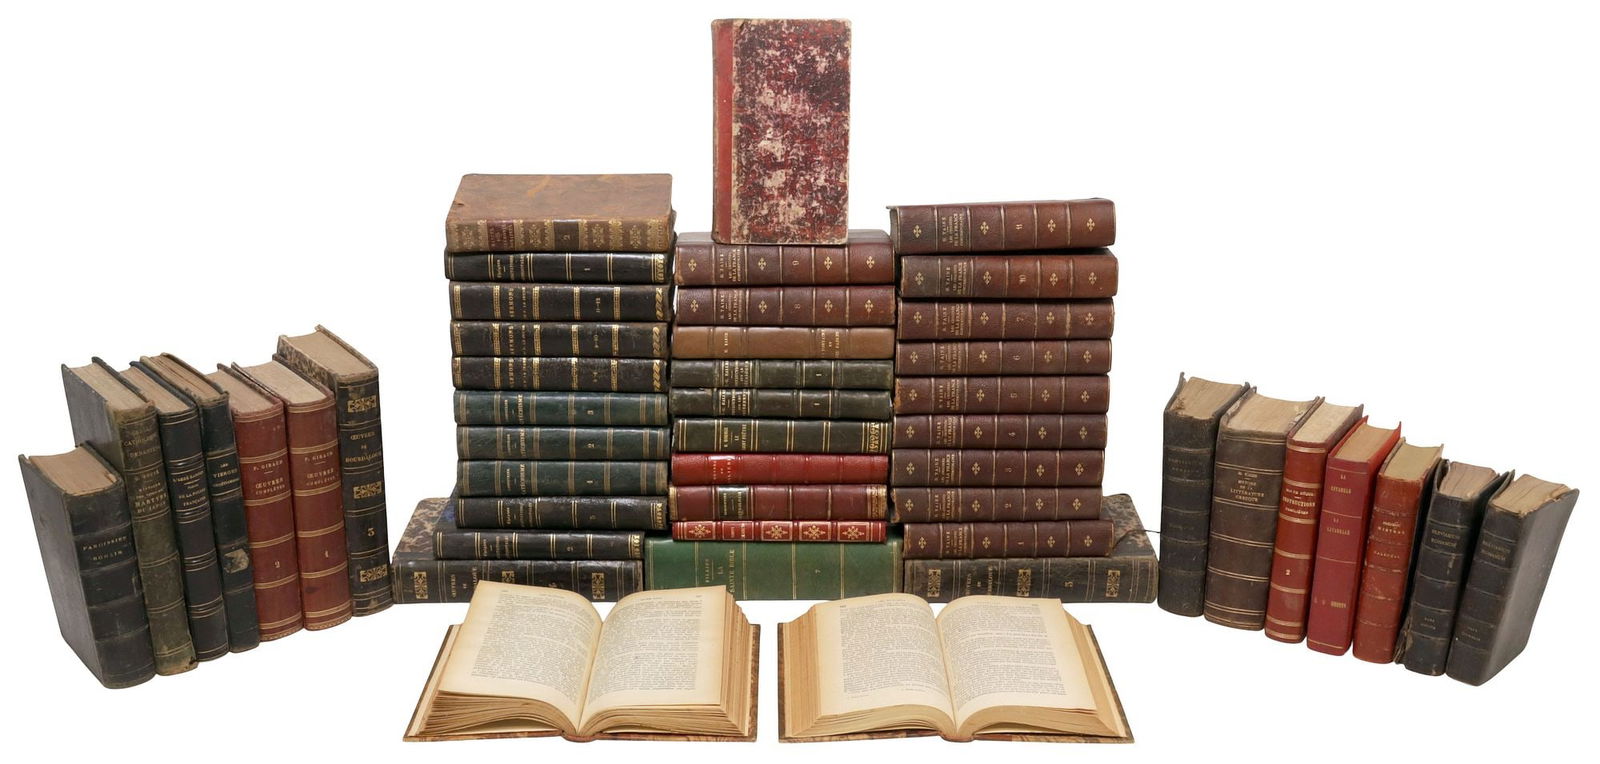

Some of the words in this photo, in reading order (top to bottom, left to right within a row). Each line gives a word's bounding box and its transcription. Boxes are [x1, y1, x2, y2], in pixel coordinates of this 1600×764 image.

[1019, 274, 1026, 284] 10
[312, 451, 333, 460] GIRAUD
[261, 459, 284, 470] GIRAUD
[306, 467, 334, 479] ŒUVRES
[255, 477, 284, 489] ŒUVRES
